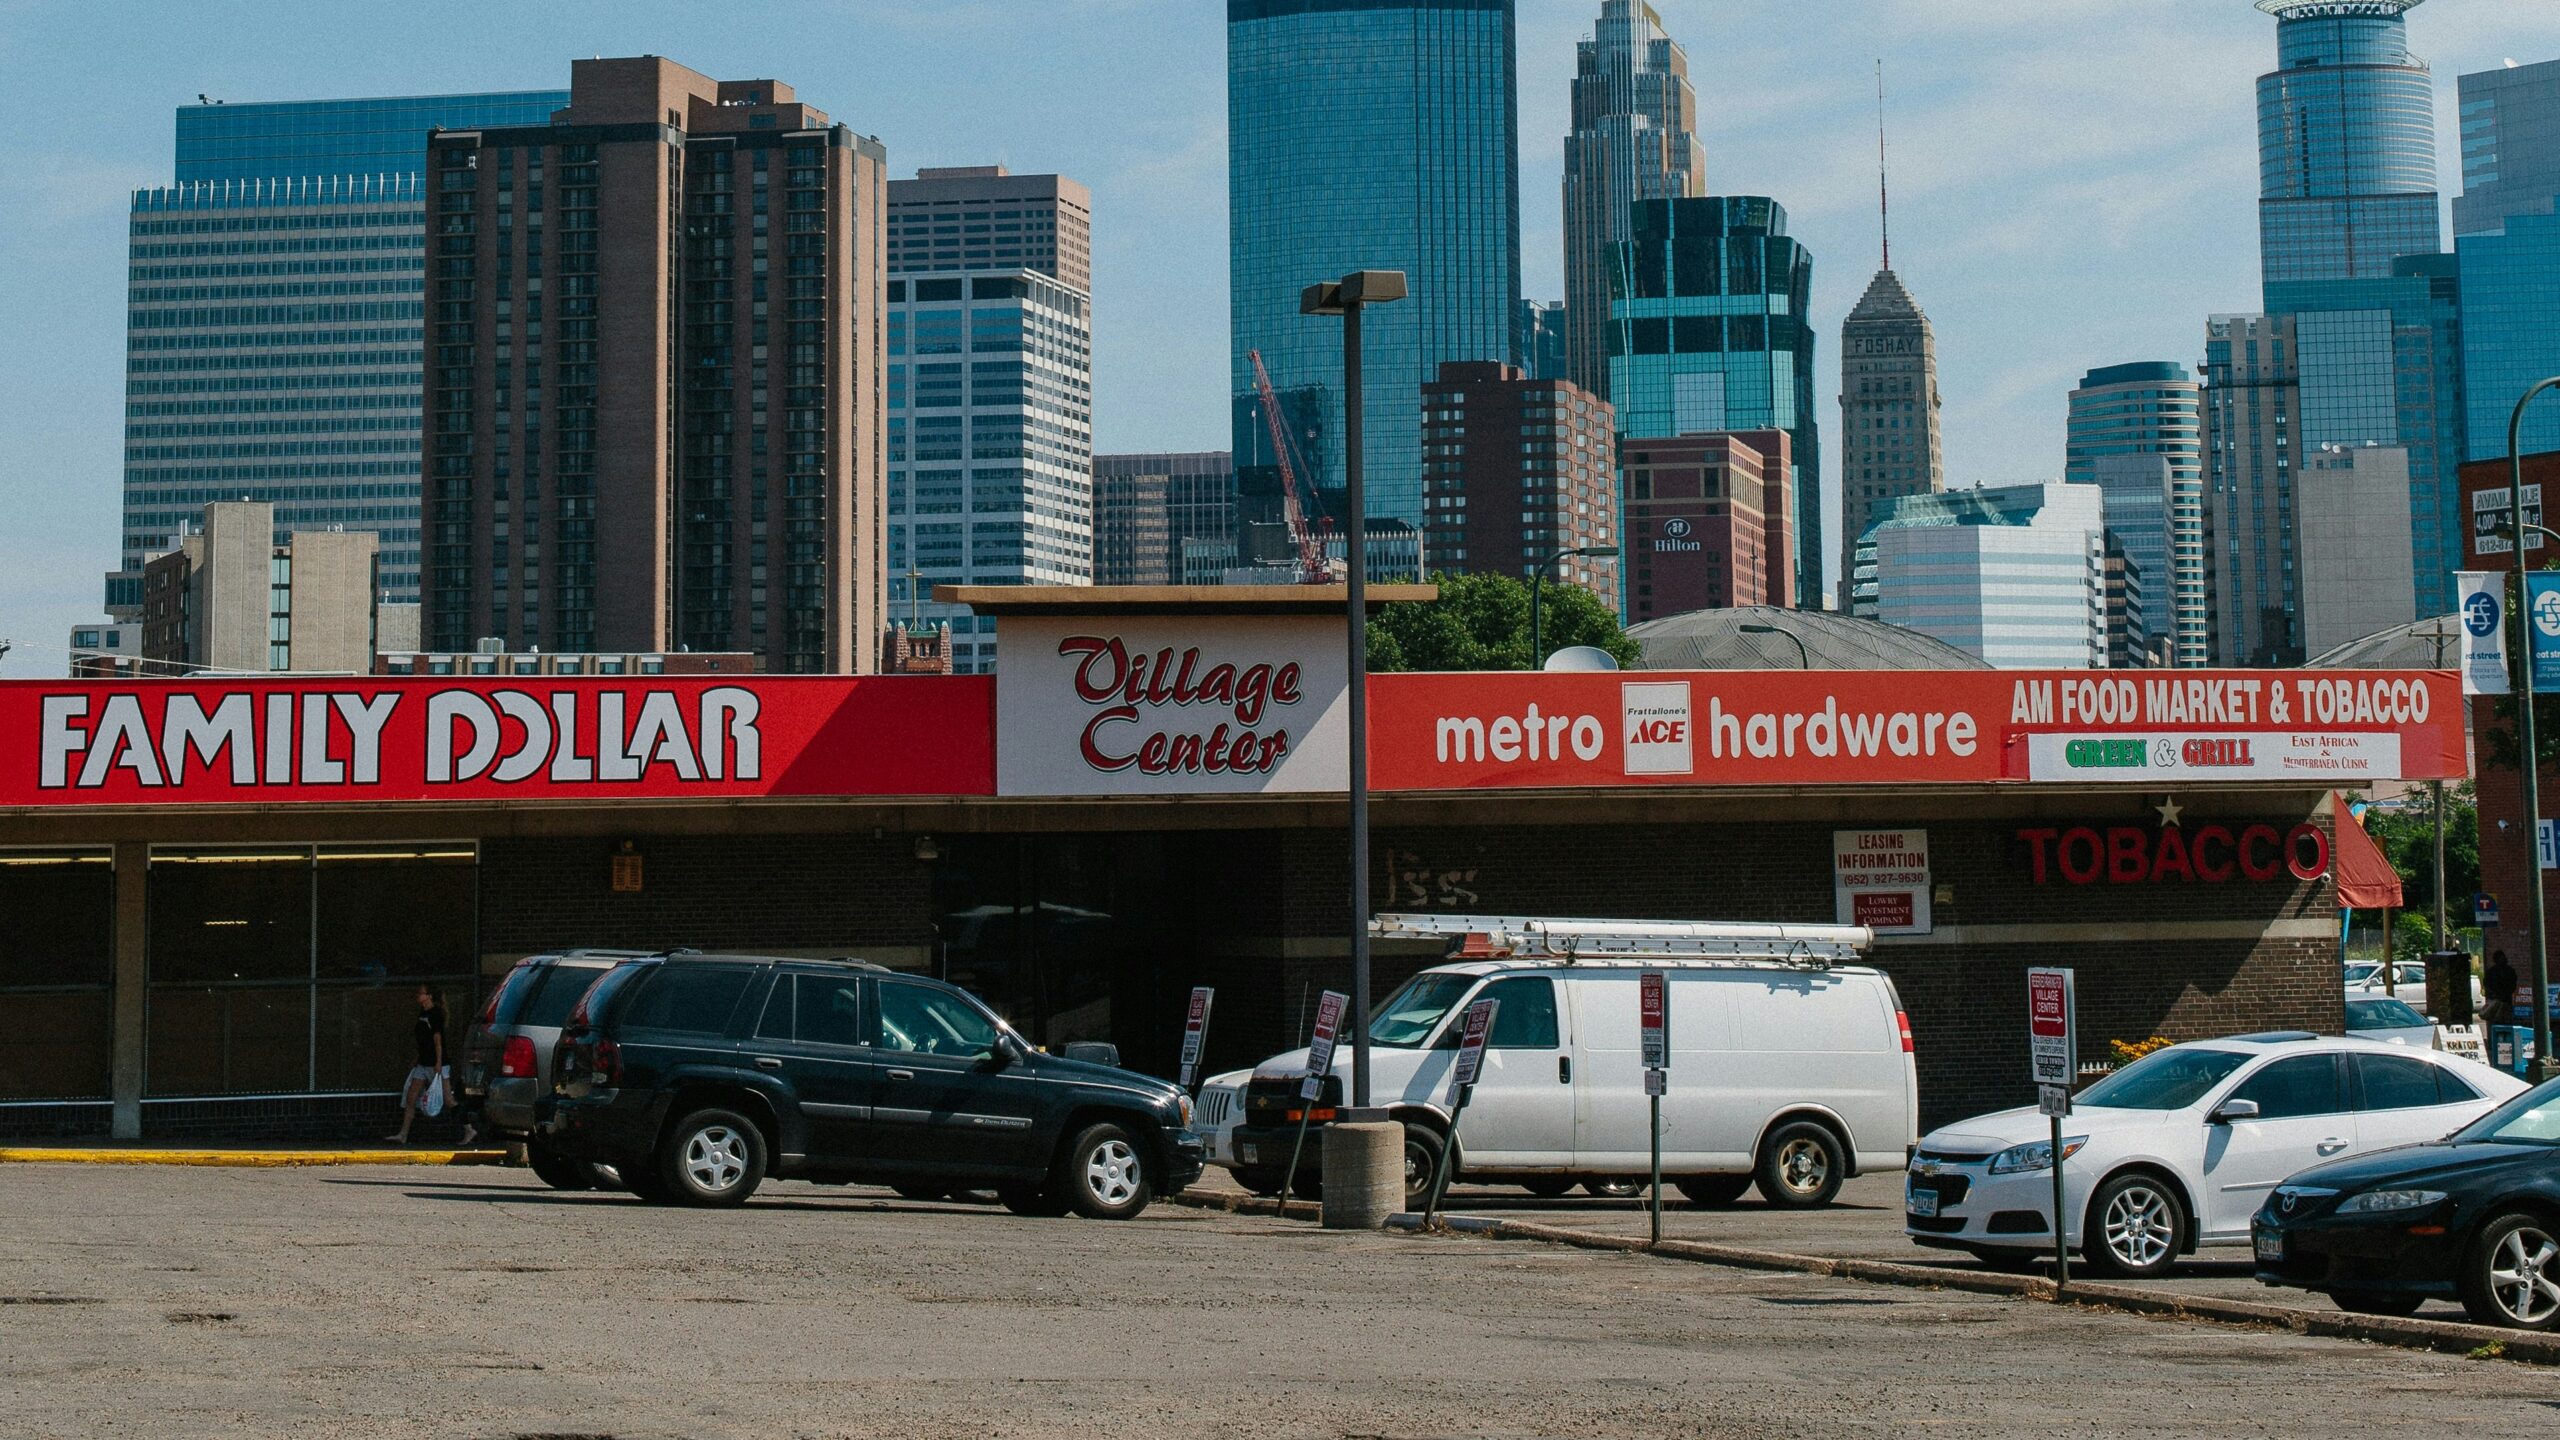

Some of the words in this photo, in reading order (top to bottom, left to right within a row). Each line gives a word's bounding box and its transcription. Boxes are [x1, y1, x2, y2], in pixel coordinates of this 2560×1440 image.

[1855, 338, 1914, 354] FOSHAY
[1655, 539, 1701, 552] Hilton
[2476, 651, 2502, 660] street
[2535, 650, 2549, 659] eat
[1059, 635, 1303, 728] Village
[2011, 679, 2054, 725] AM
[2062, 679, 2138, 725] FOOD
[2147, 679, 2261, 725] MARKET
[2270, 680, 2291, 724] &
[2298, 678, 2430, 725] TOBACCO
[1628, 707, 1687, 716] Frattallone's
[1436, 702, 1604, 763] metro
[1630, 718, 1686, 744] ACE
[1710, 695, 1978, 759] hardware
[38, 692, 404, 789] FAMILY
[424, 686, 762, 784] DOLLAR
[1080, 704, 1291, 776] Center
[2291, 735, 2316, 747] EAST
[2320, 735, 2359, 747] AFRICAN
[2065, 739, 2147, 767] GREEN
[2154, 738, 2177, 768] &
[2181, 738, 2255, 767] GRILL
[1858, 833, 1904, 850] LEASING
[1838, 852, 1925, 869] INFORMATION
[2017, 823, 2330, 885] TOBACCO
[1844, 873, 1869, 887] (952)
[1857, 906, 1910, 915] INVESTMENT
[1863, 915, 1904, 925] COMPANY
[2035, 989, 2059, 1001] VILLAGE
[2036, 1001, 2059, 1014] CENTER
